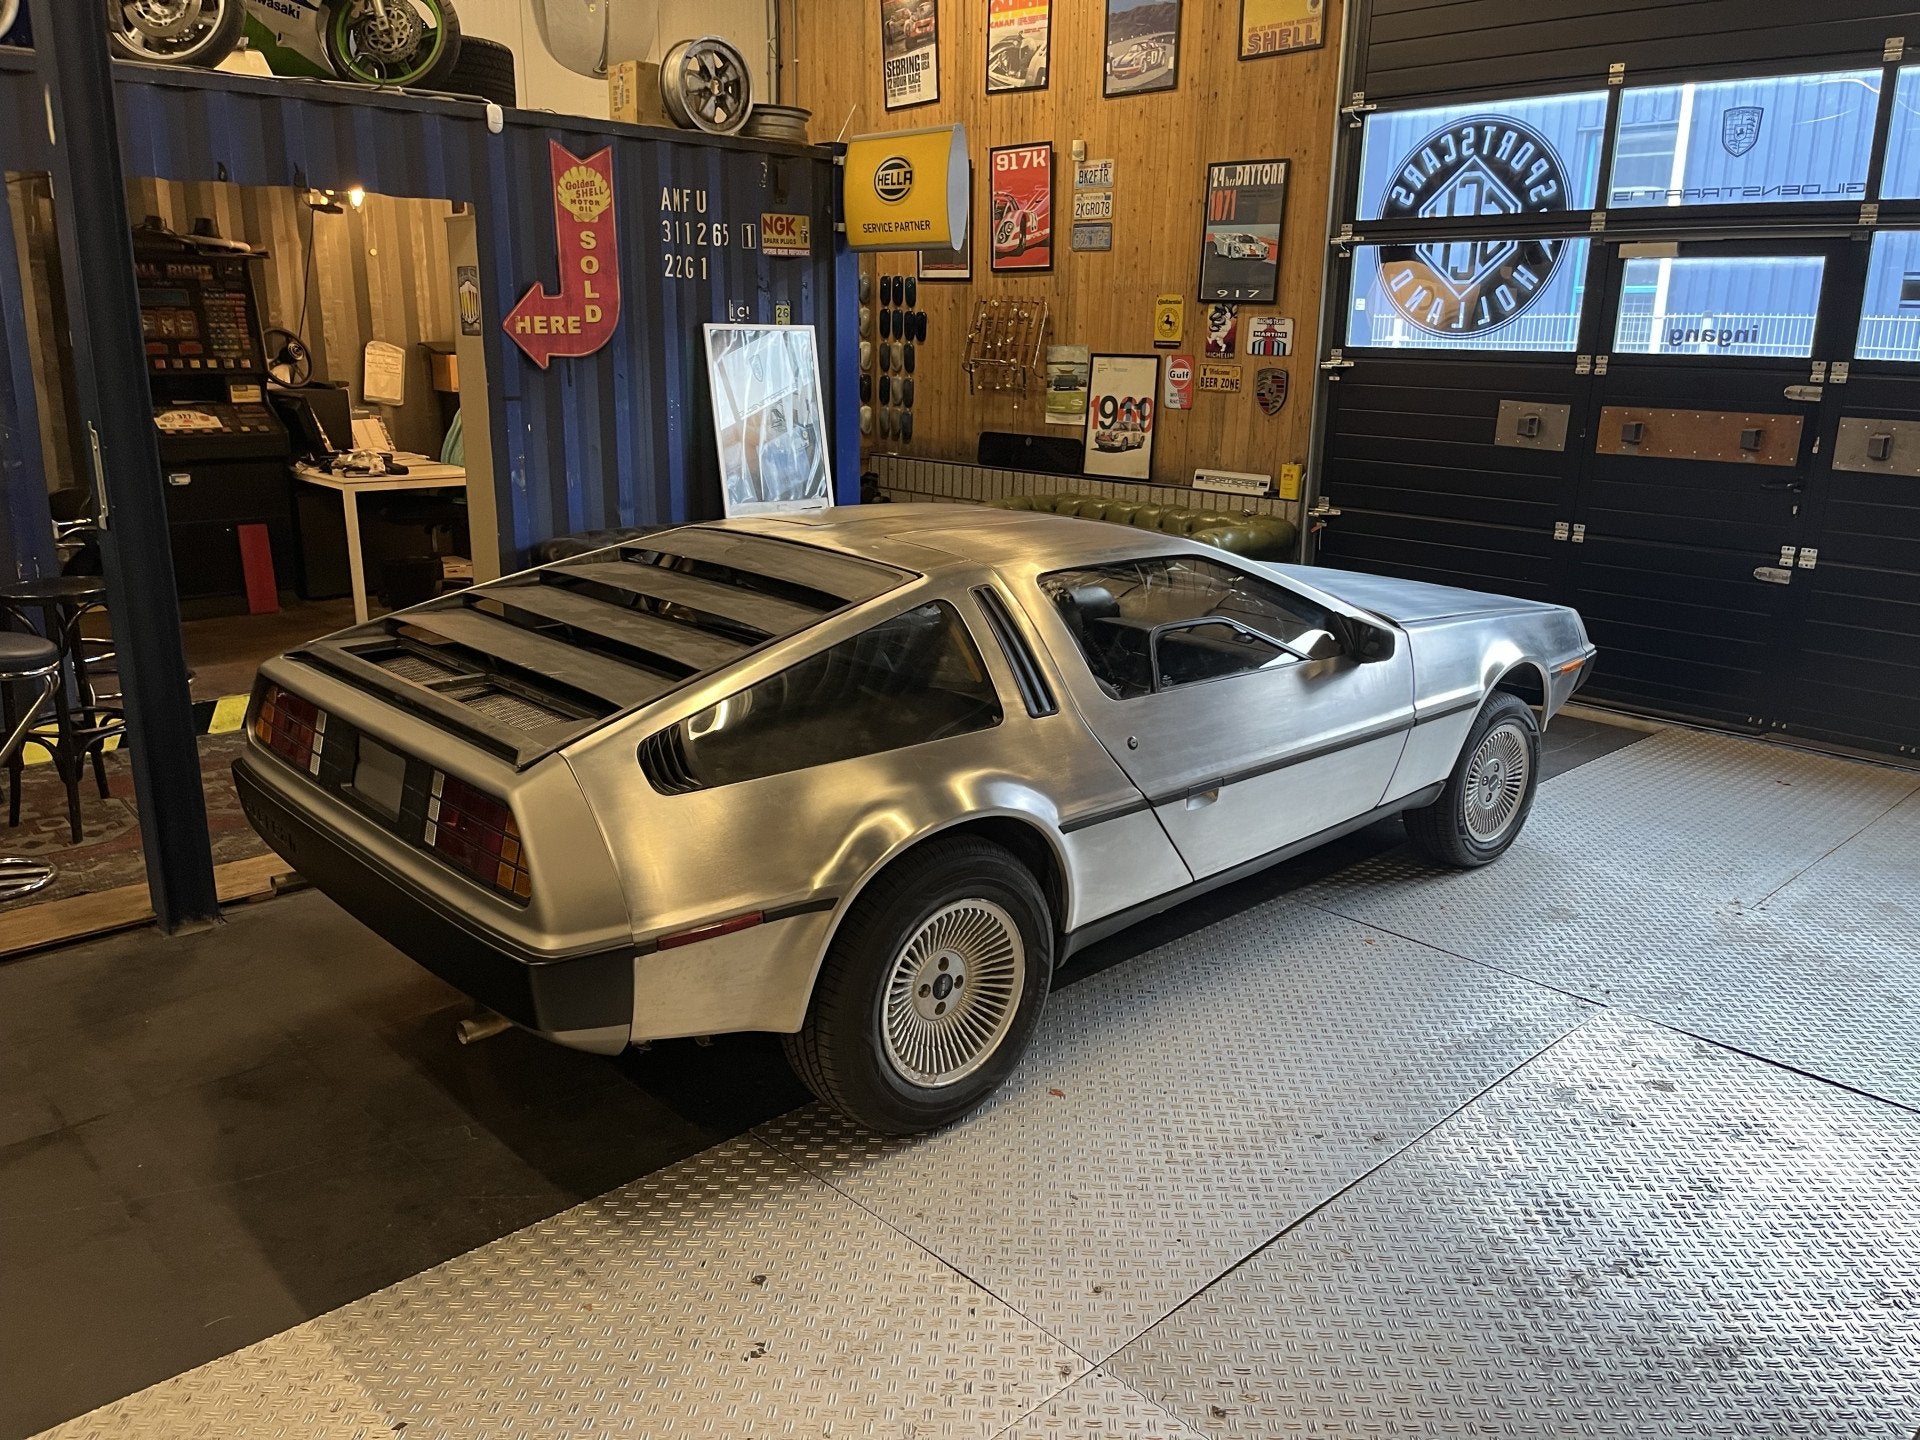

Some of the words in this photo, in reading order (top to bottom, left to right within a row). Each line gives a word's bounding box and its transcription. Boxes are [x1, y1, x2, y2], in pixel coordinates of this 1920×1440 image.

[1247, 25, 1316, 54] SHELL
[886, 55, 920, 78] SEBRING
[996, 150, 1046, 172] 917K
[565, 179, 596, 190] Golden
[877, 170, 913, 187] HELLA
[1212, 167, 1225, 187] 24
[1235, 164, 1285, 186] DAYTONA
[570, 198, 601, 206] MOTOR
[575, 186, 604, 199] SHELL
[661, 220, 729, 247] 311265
[763, 215, 796, 237] NGK
[862, 222, 893, 233] SERVICE
[894, 219, 931, 232] PARTNER
[664, 253, 707, 280] 22G1
[580, 230, 602, 323] SOLD
[1217, 289, 1260, 298] 917
[515, 315, 582, 334] HERE
[1169, 369, 1190, 379] Gulf
[1200, 377, 1218, 388] BEER
[1220, 378, 1240, 389] ZONE
